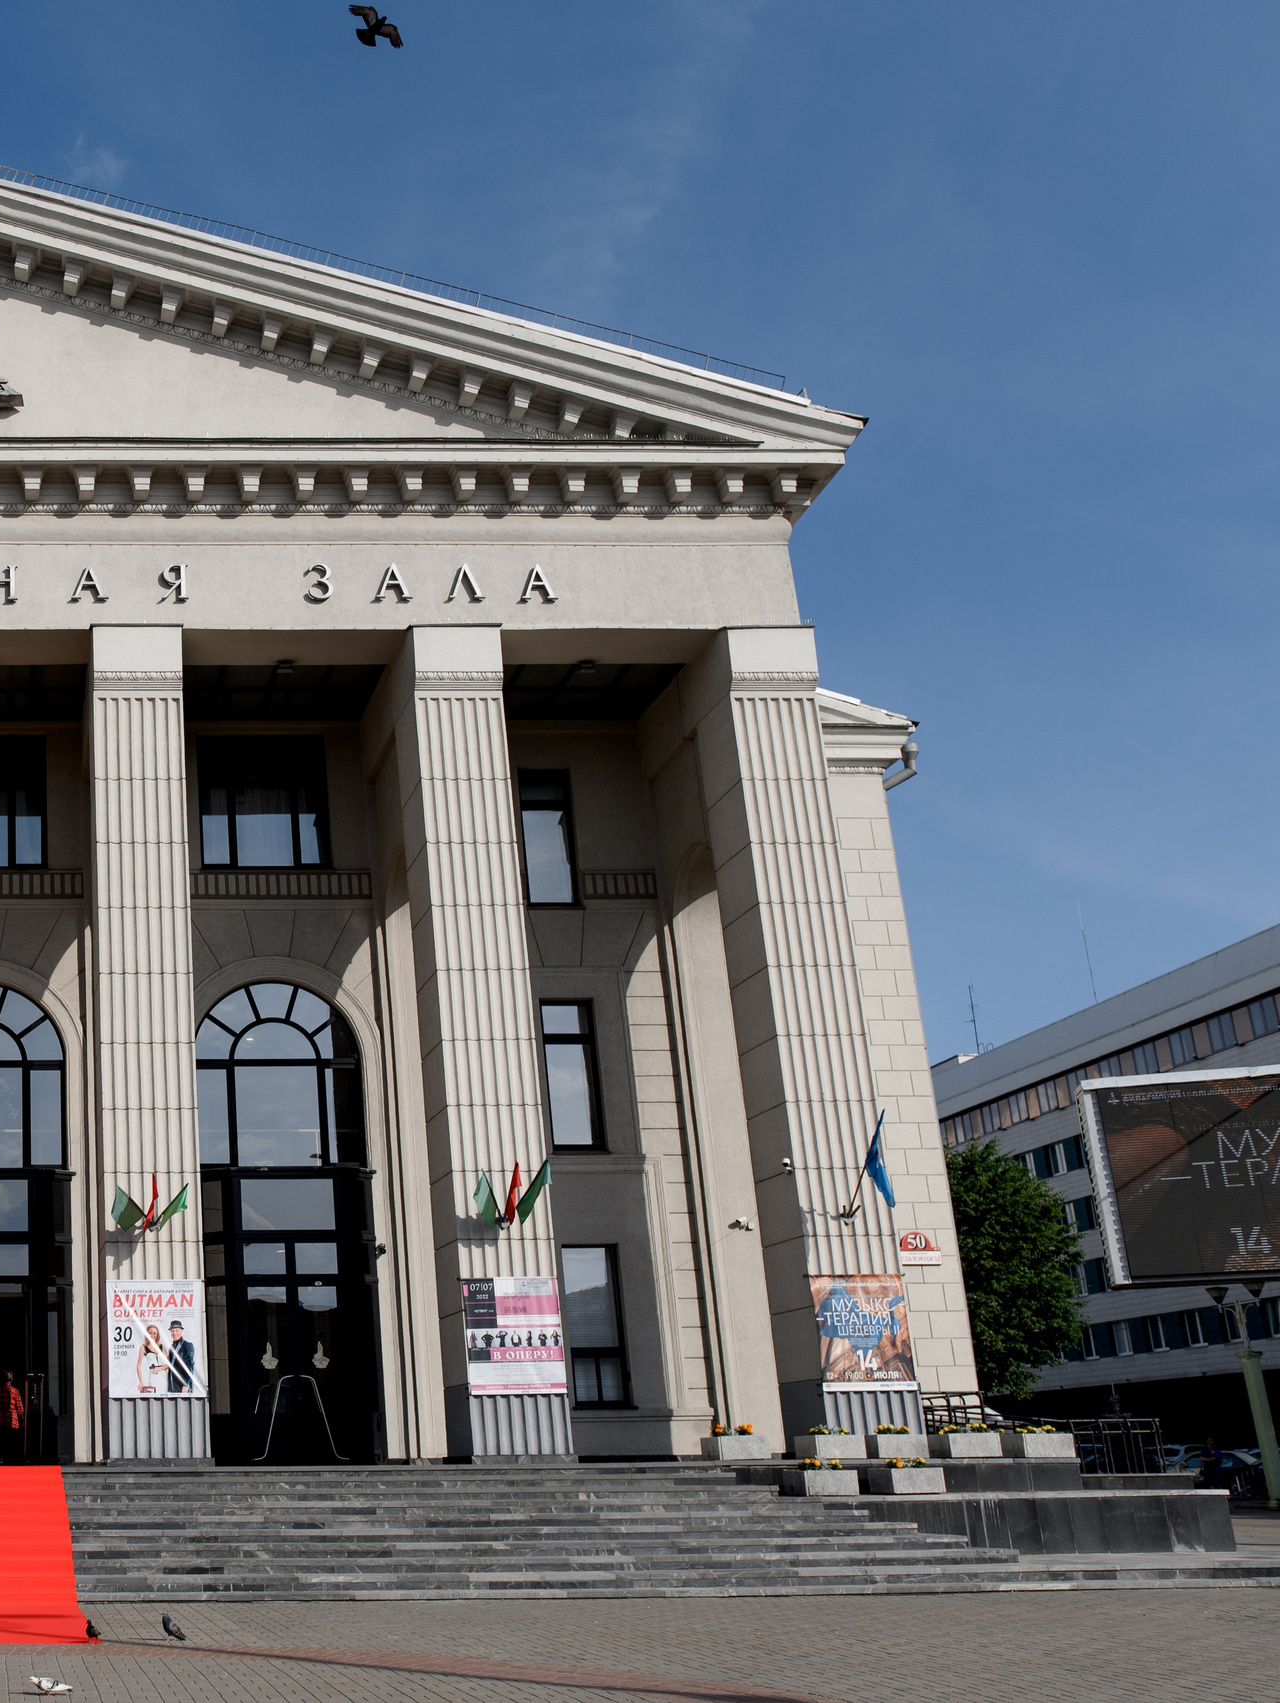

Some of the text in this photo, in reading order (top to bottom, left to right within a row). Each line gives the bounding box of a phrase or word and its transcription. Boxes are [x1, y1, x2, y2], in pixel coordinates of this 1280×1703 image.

[306, 563, 558, 603] ЗАЛА
[907, 1234, 927, 1250] 50
[1230, 1226, 1271, 1255] 14
[113, 1293, 194, 1308] BUTMAN
[831, 1298, 893, 1312] МУЗЫКО
[113, 1309, 164, 1318] QUARTET
[113, 1326, 133, 1342] 30
[837, 1325, 890, 1337] ШЕДЕВРЫ
[493, 1350, 554, 1360] В ОПЕРУ!
[856, 1349, 878, 1371] 14
[826, 1372, 838, 1380] 12+
[873, 1371, 899, 1380] ИЮЛЯ
